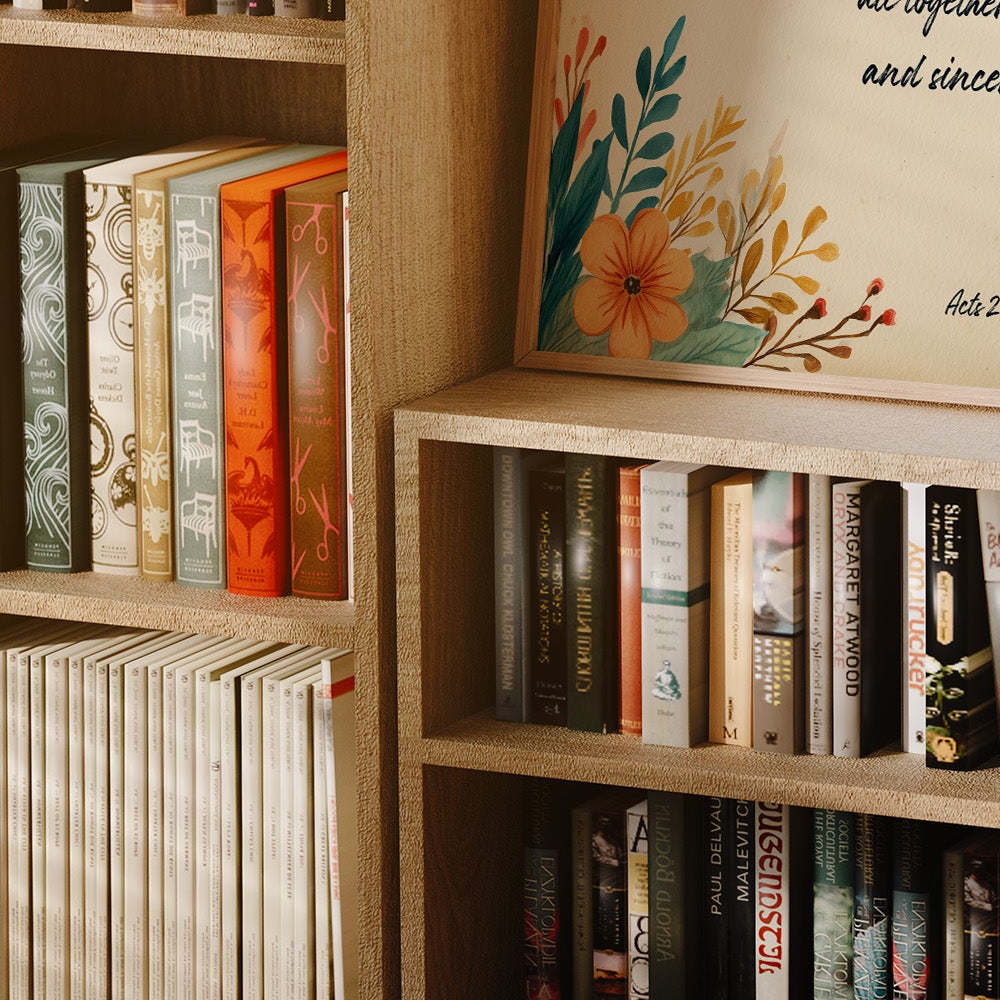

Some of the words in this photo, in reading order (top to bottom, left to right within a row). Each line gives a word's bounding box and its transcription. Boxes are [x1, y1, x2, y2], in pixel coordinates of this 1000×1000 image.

[862, 55, 927, 88] and
[944, 288, 985, 318] Acts
[501, 455, 514, 529] DOWNTOWN
[834, 493, 845, 544] ORYX
[502, 531, 514, 557] OWL
[651, 537, 682, 551] Theory
[846, 493, 860, 606] MARGARET
[502, 563, 514, 606] CHUCK
[834, 548, 845, 595] AND
[502, 609, 514, 691] KLOSTERMAN
[834, 600, 845, 670] CRAKE
[845, 612, 860, 698] ATWOOD
[812, 641, 823, 689] Splendid
[813, 692, 823, 740] Isolation
[710, 871, 723, 916] PAUL
